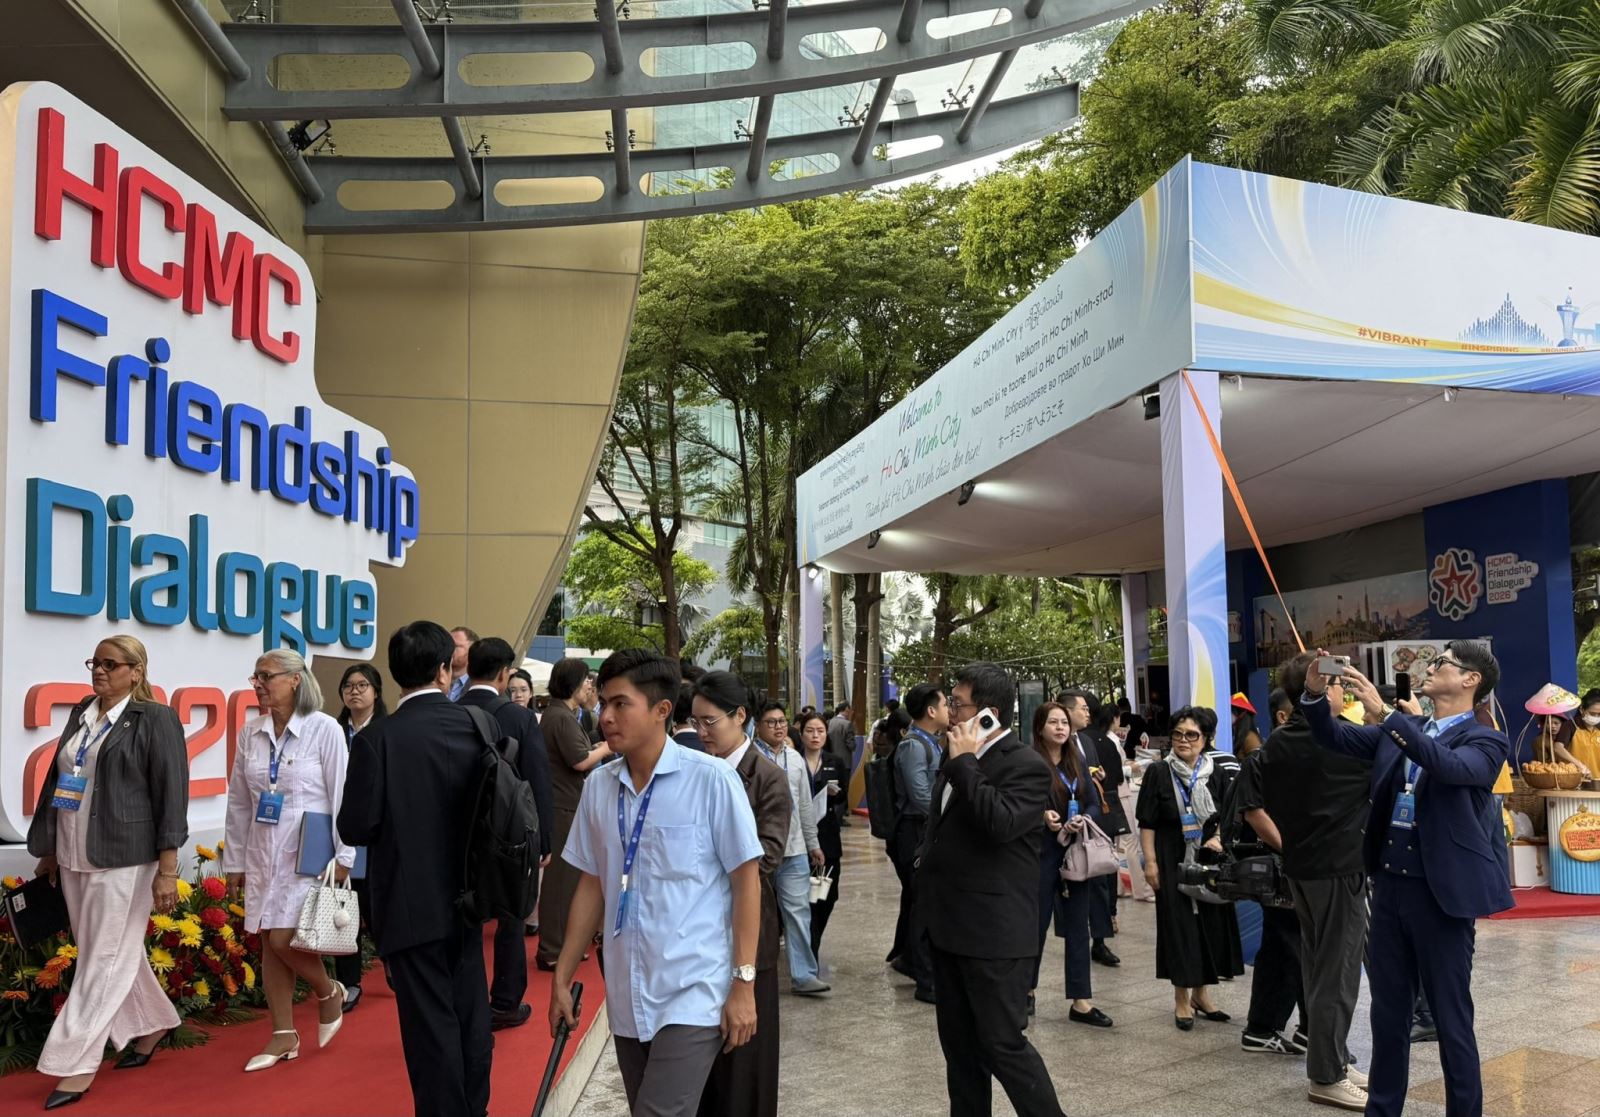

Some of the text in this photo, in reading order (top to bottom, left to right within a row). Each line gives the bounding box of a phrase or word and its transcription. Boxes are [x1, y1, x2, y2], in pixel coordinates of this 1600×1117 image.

[34, 106, 301, 363] HCMC
[1015, 339, 1041, 366] Welkom
[1049, 325, 1060, 341] Ho
[1060, 314, 1073, 332] Chi
[1074, 280, 1114, 324] Minh-stad
[1357, 326, 1430, 347] #VIBRANT
[1045, 352, 1056, 368] Ho
[1056, 340, 1069, 361] Chi
[1070, 327, 1090, 350] Minh
[1081, 353, 1091, 370] Хо
[1092, 345, 1105, 362] Ши
[1106, 333, 1125, 354] Мин
[30, 288, 420, 558] Friendship
[898, 397, 933, 438] Welcome
[880, 455, 893, 486] Ho
[893, 444, 911, 475] Chi
[912, 423, 939, 465] Minh
[940, 410, 962, 449] City
[25, 477, 375, 657] Dialogue
[1487, 555, 1512, 568] HCMC
[1488, 562, 1532, 579] Friendship
[1488, 578, 1525, 590] Dialogue
[1488, 590, 1511, 602] 2026
[22, 682, 271, 817] 22
